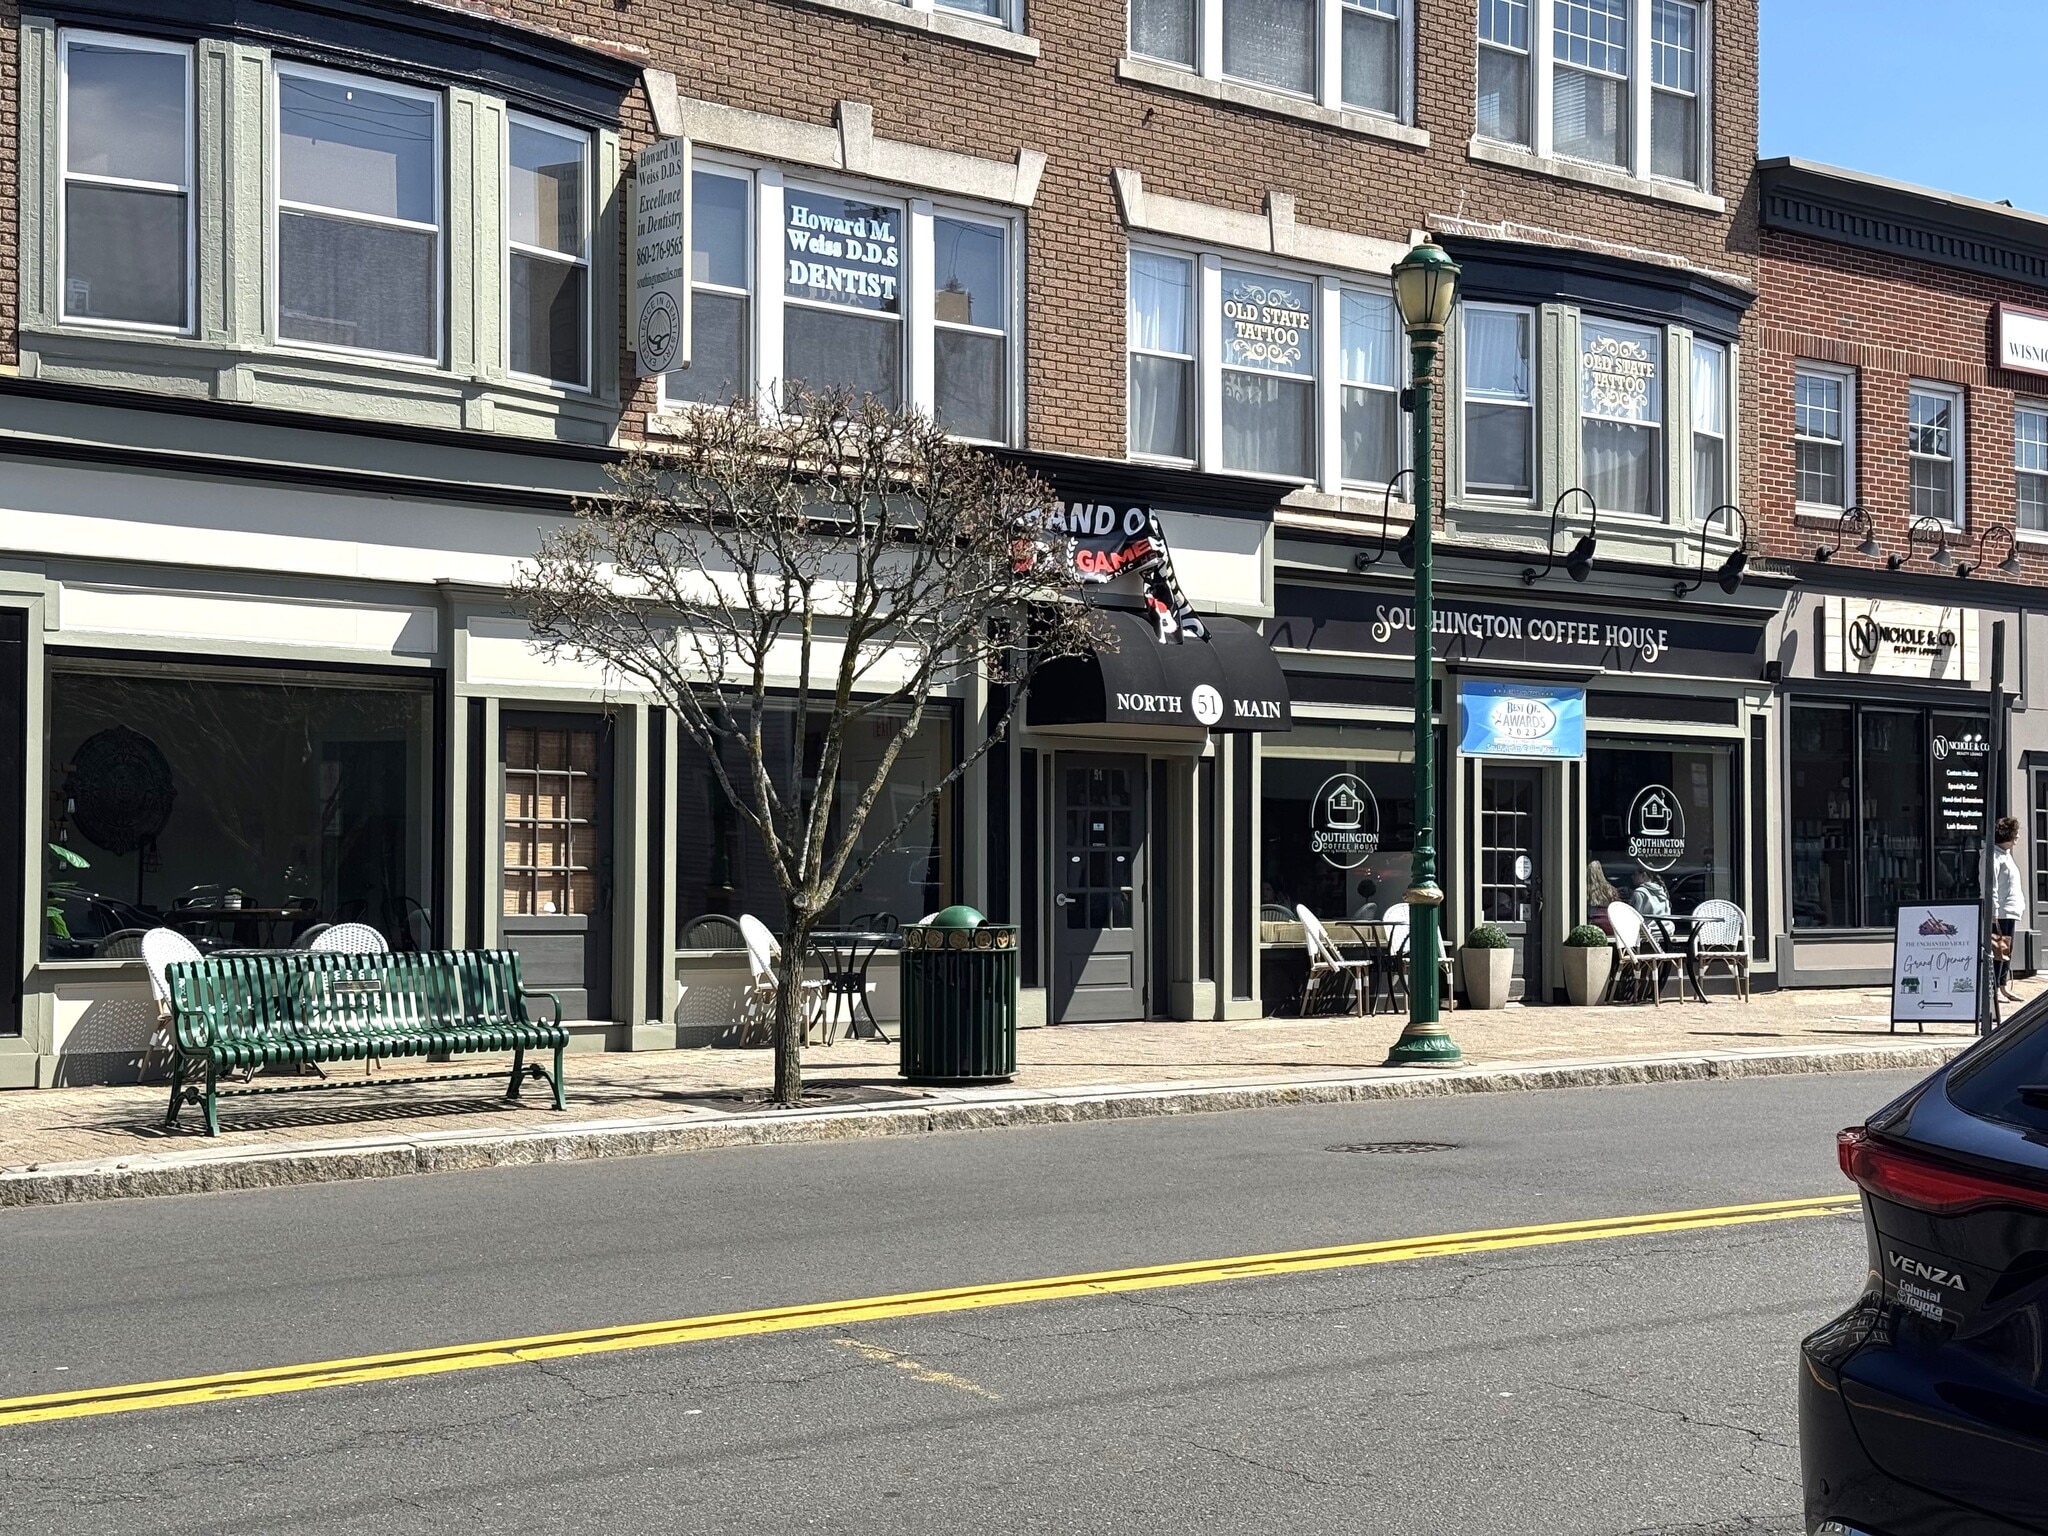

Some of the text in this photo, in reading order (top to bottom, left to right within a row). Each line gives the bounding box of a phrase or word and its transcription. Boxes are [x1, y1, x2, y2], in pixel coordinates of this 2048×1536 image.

[641, 140, 680, 168] Howard M.
[639, 159, 682, 187] Weiss D.D.S
[639, 188, 681, 214] Excellence
[637, 210, 682, 237] in Dentistry
[790, 204, 895, 243] Howard M.
[636, 235, 683, 267] 860-276-9565
[787, 228, 898, 268] Weiss D.D.S
[788, 259, 896, 300] DENTIST
[1223, 300, 1310, 330] OLD STATE
[1235, 321, 1299, 346] TATTOO
[1583, 352, 1655, 378] OLD STATE
[1591, 371, 1646, 393] TATTOO
[1371, 604, 1669, 663] SOUHINGTON COFFEE HOUSE
[1879, 625, 1926, 646] NICHOLE
[1927, 630, 1938, 646] &
[1116, 693, 1281, 719] NORTH 51 MAIN
[1507, 701, 1525, 714] BEST
[1503, 714, 1546, 729] AWARDS
[1949, 741, 1973, 751] NICHOLE
[1974, 741, 1980, 751] &
[1093, 768, 1103, 781] 51
[1311, 830, 1380, 853] SOUTHINGTON
[1322, 842, 1351, 850] COFFEE
[1354, 843, 1378, 853] HOUSE
[1628, 836, 1685, 857] SOUTHINGTON
[1664, 848, 1685, 857] HOUSE
[1903, 951, 1973, 974] Grand Opening
[1888, 1249, 1966, 1292] VENZA
[1900, 1279, 1941, 1304] Colonial
[1905, 1292, 1944, 1317] Toyota
